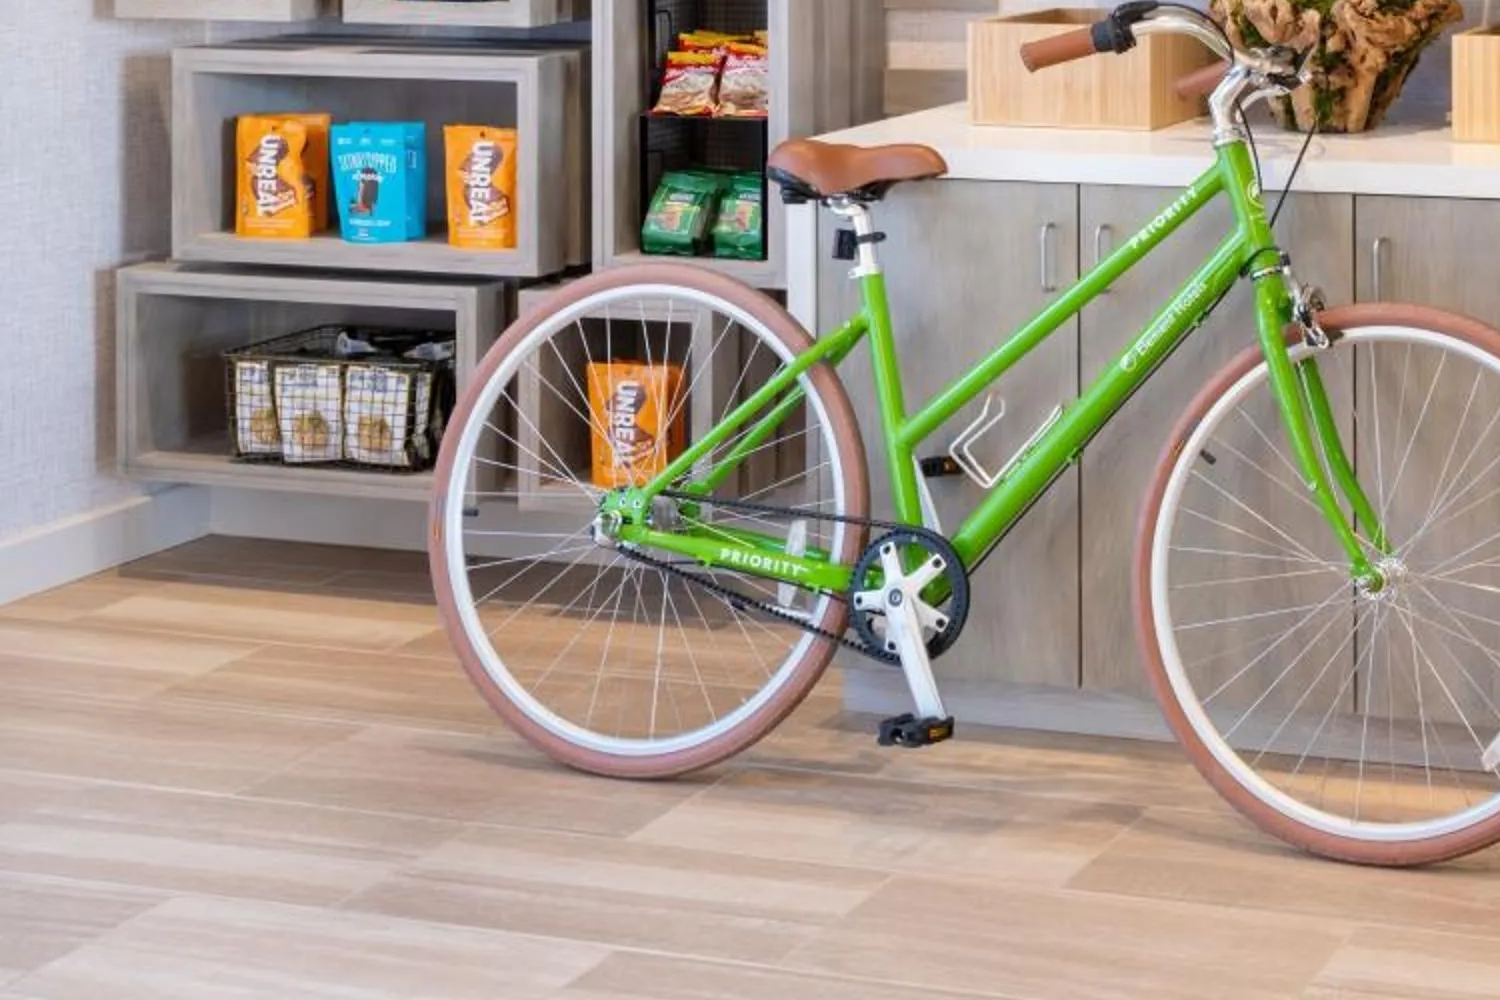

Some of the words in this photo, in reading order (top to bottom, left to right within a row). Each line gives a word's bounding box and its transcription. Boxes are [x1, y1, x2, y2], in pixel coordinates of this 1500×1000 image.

[256, 134, 281, 218] UNREAL
[470, 141, 494, 227] UNREAL
[1130, 184, 1197, 248] PRIORITY
[720, 547, 805, 578] PRIORITY
